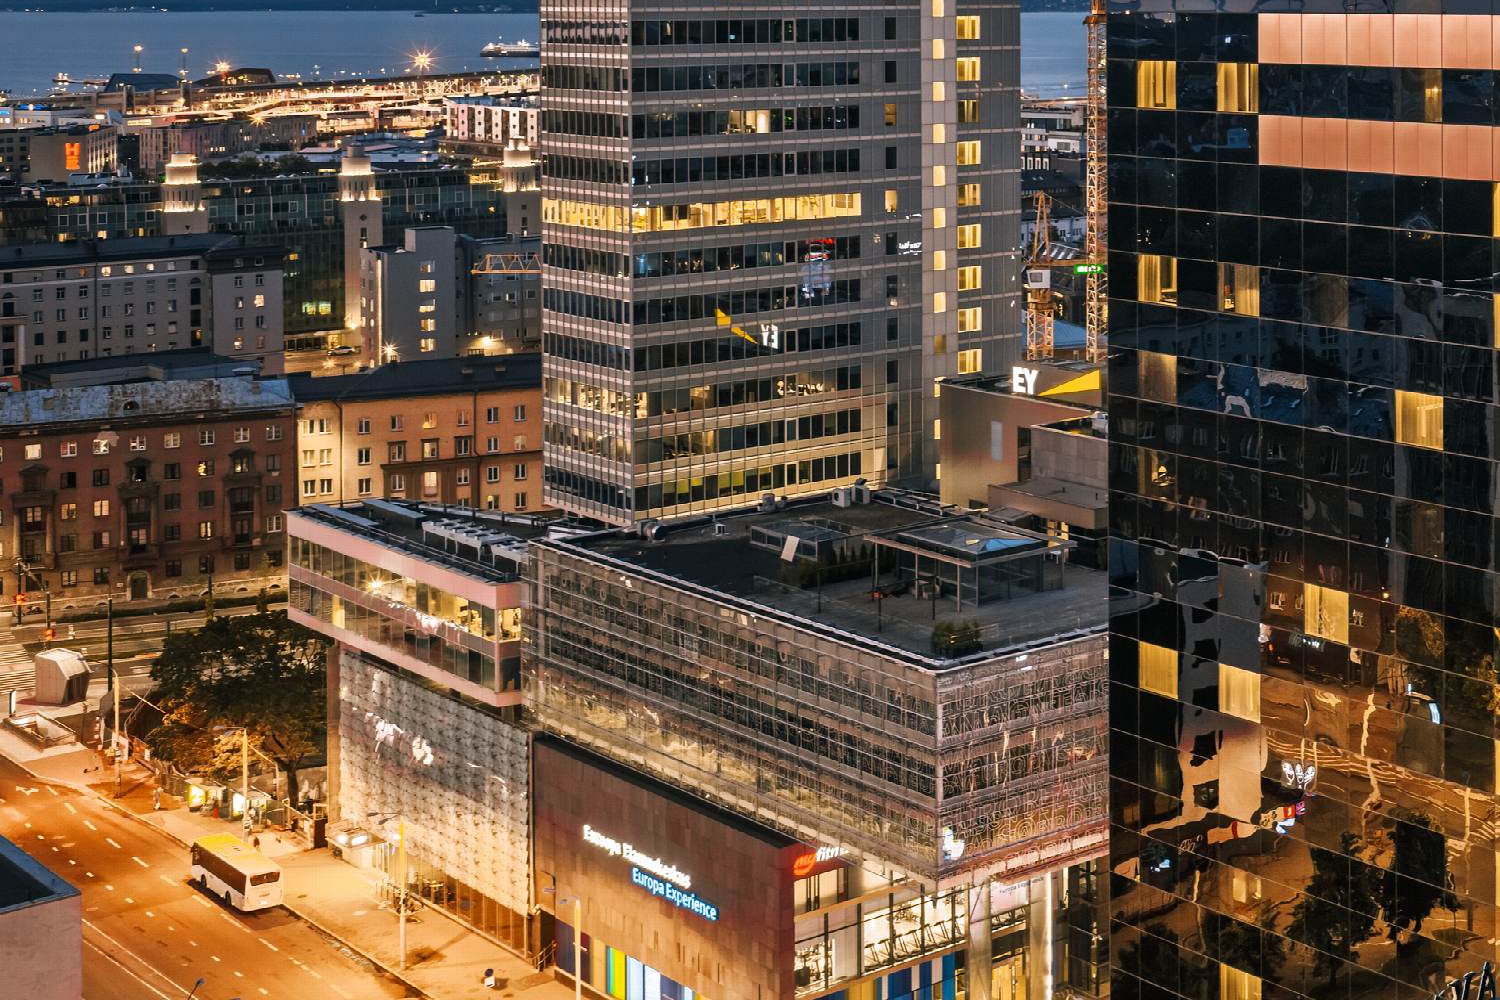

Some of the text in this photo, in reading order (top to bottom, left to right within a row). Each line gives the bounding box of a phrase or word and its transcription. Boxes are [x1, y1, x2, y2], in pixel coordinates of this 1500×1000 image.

[1012, 366, 1039, 396] EY
[632, 867, 717, 921] Europa Experience
